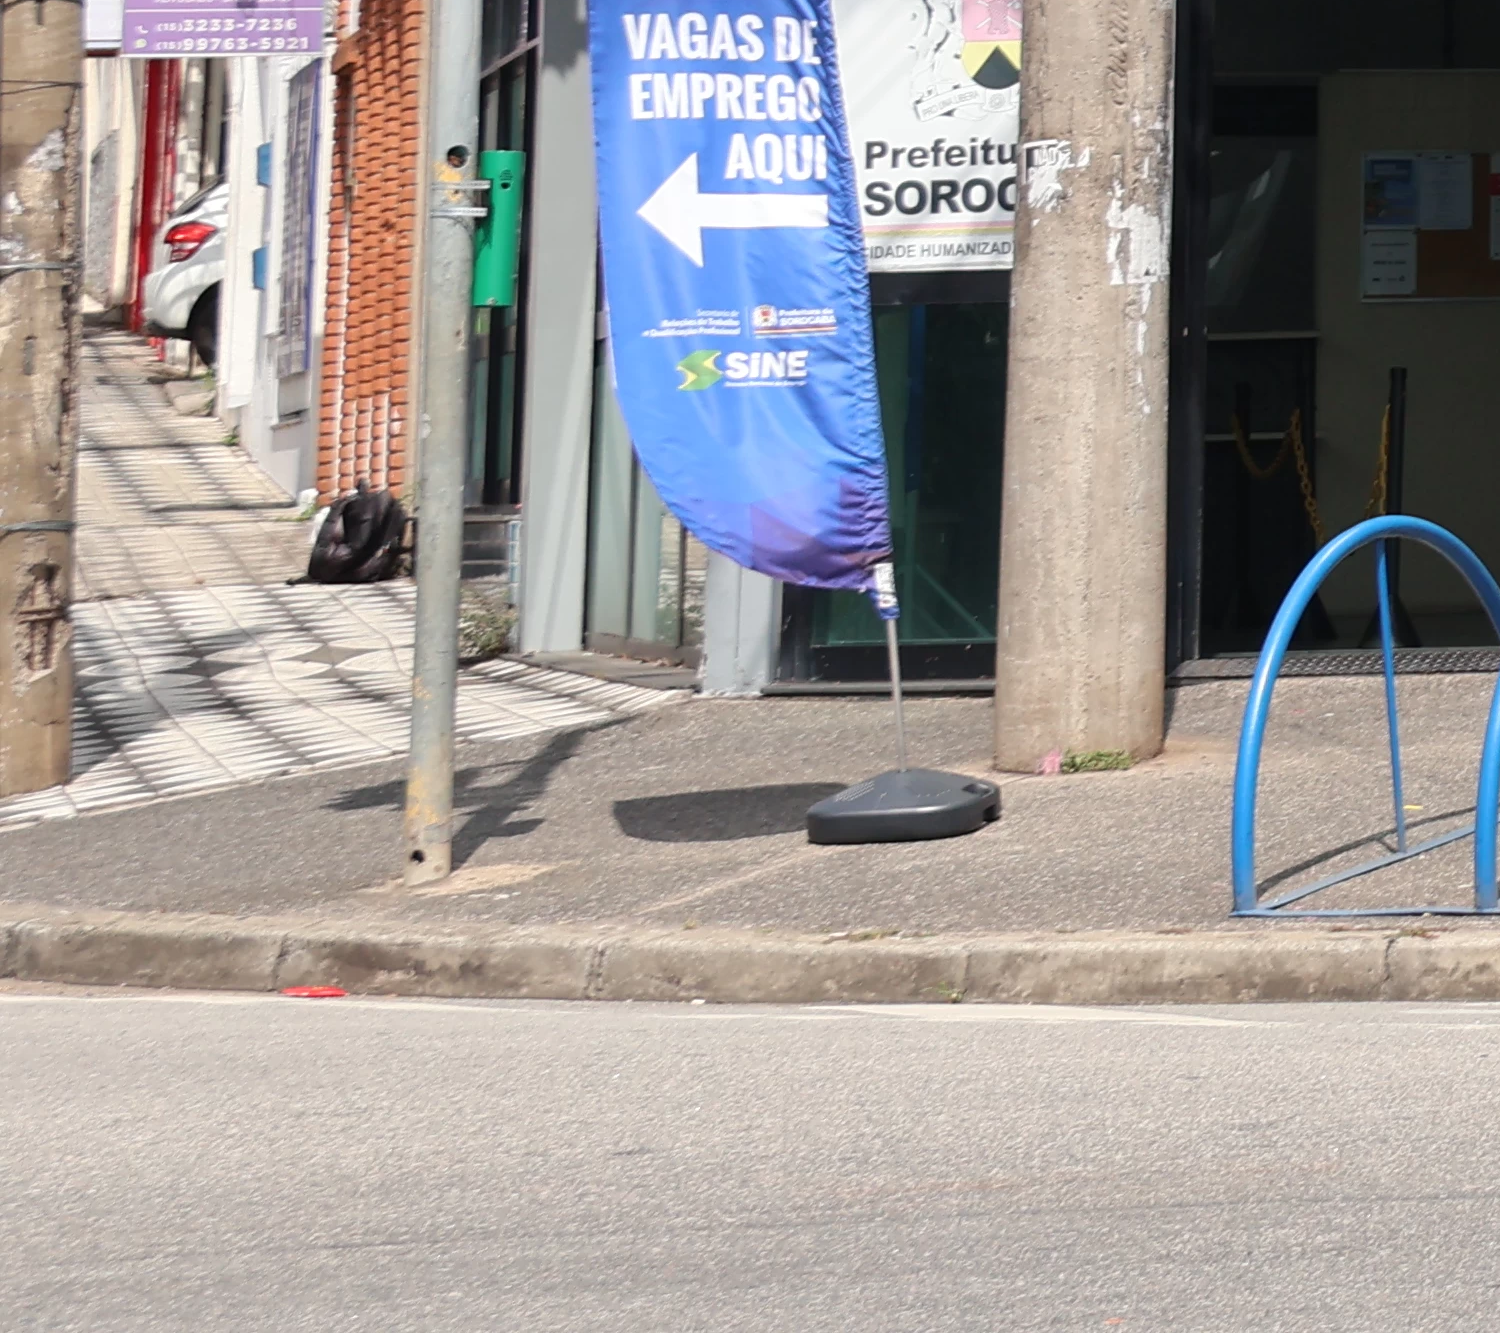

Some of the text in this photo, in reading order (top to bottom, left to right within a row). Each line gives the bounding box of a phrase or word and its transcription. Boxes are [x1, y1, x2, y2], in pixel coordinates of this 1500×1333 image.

[155, 17, 299, 33] (15)3233-7236
[621, 12, 822, 66] VAGAS DE
[154, 36, 310, 52] (15)99763-5921
[629, 72, 823, 123] EMPREGO
[724, 132, 828, 186] AQUI
[865, 241, 1014, 259] IDADE HUMANIZAD
